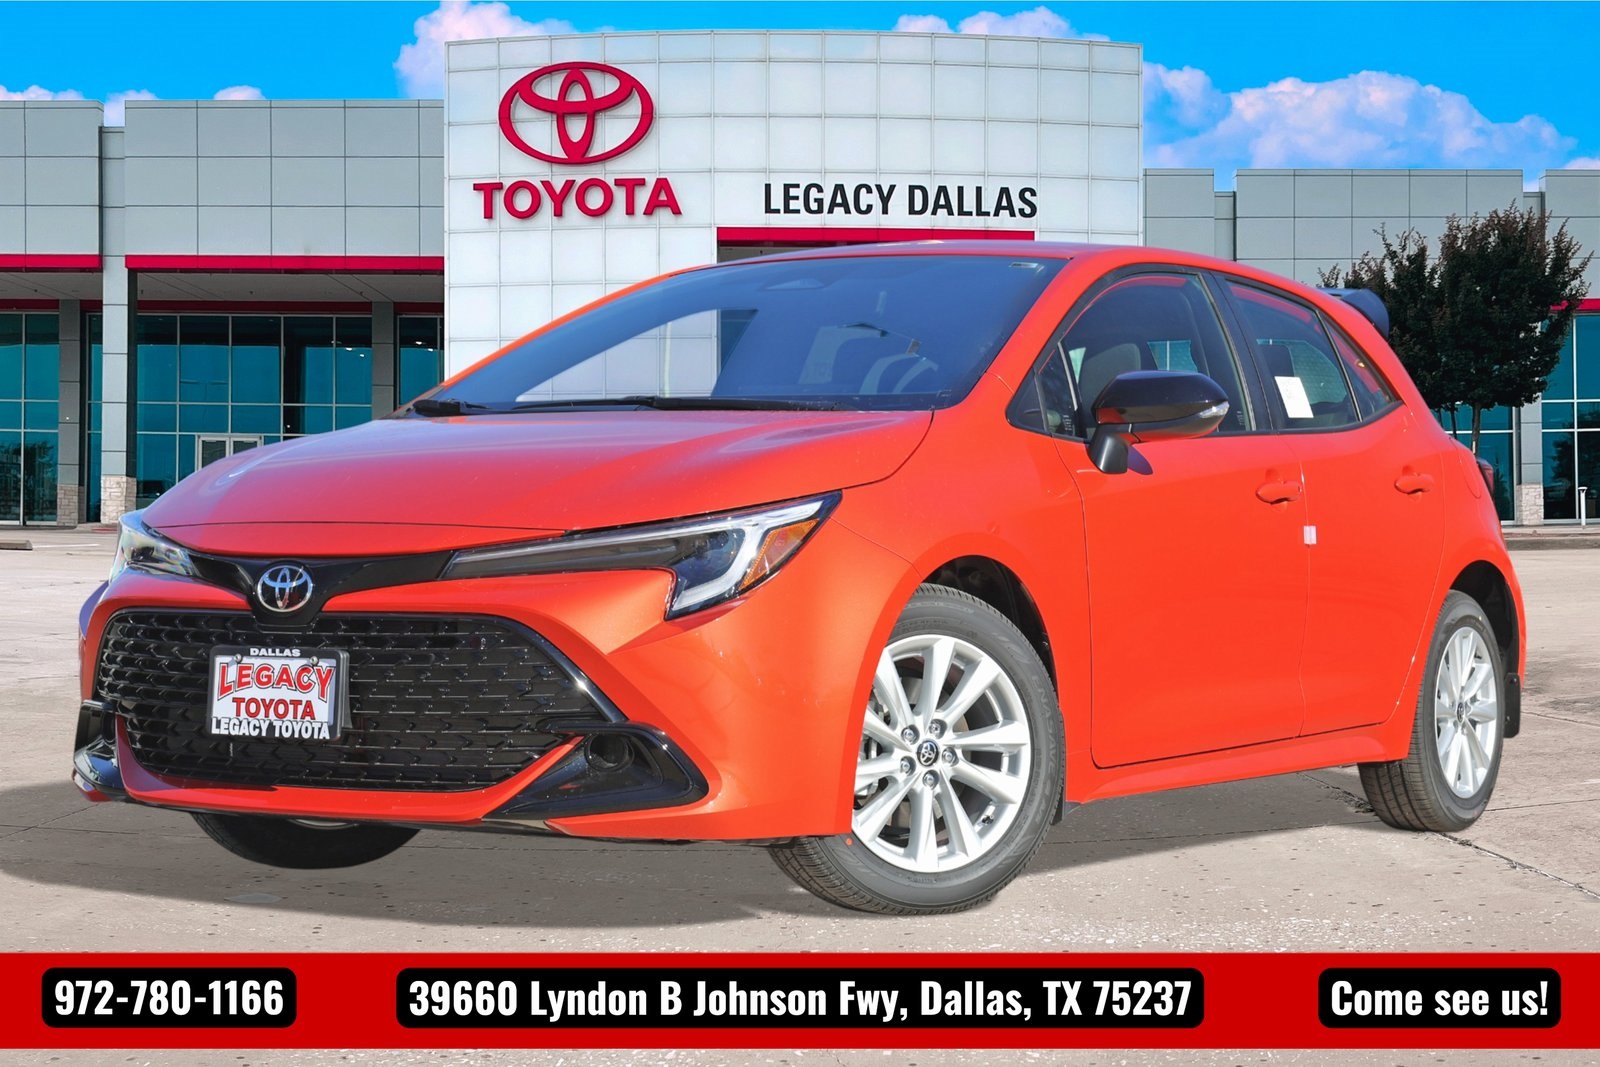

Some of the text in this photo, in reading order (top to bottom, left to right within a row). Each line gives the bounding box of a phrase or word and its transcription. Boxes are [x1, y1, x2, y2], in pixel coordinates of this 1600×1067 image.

[473, 177, 682, 220] TOYOTA
[764, 183, 1038, 218] LEGACY DALLAS
[250, 648, 301, 657] DALLAS
[217, 663, 335, 703] LEGACY
[232, 697, 316, 720] TOYOTA
[211, 717, 330, 739] LEGACY TOYOTA
